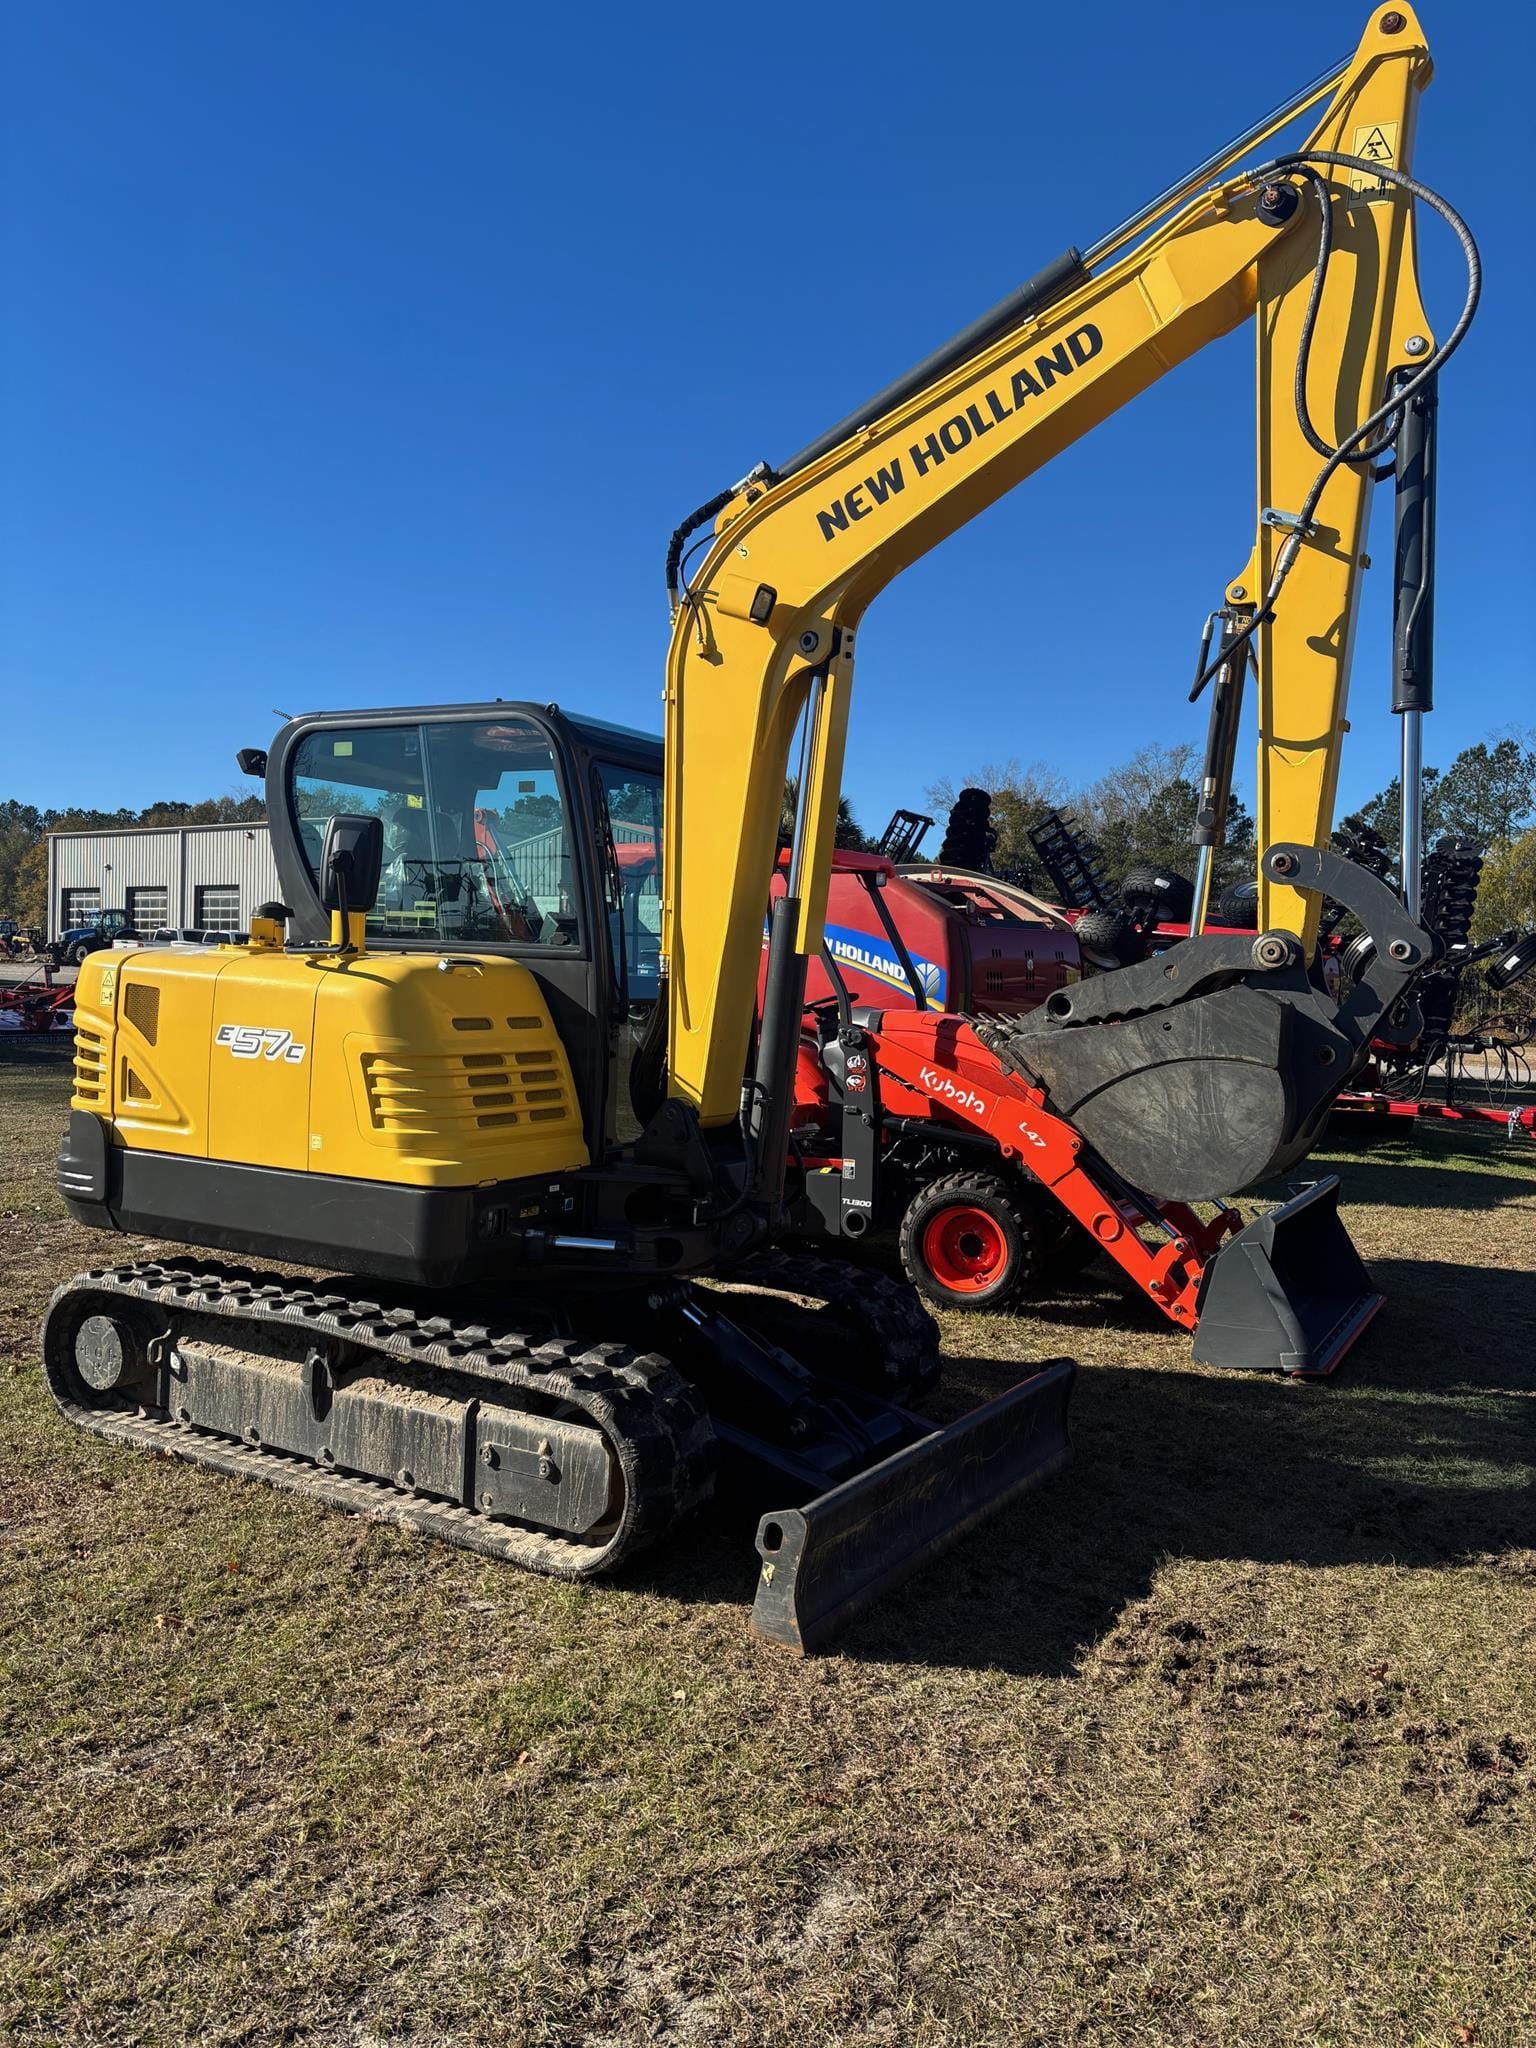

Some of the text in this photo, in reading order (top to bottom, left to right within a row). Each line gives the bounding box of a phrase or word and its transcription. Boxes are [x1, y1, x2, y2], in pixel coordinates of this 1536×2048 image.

[816, 322, 1104, 543] NEW HOLLAND
[835, 940, 906, 981] HOLLAND
[919, 1066, 986, 1115] Kubota
[1018, 1121, 1048, 1148] L47
